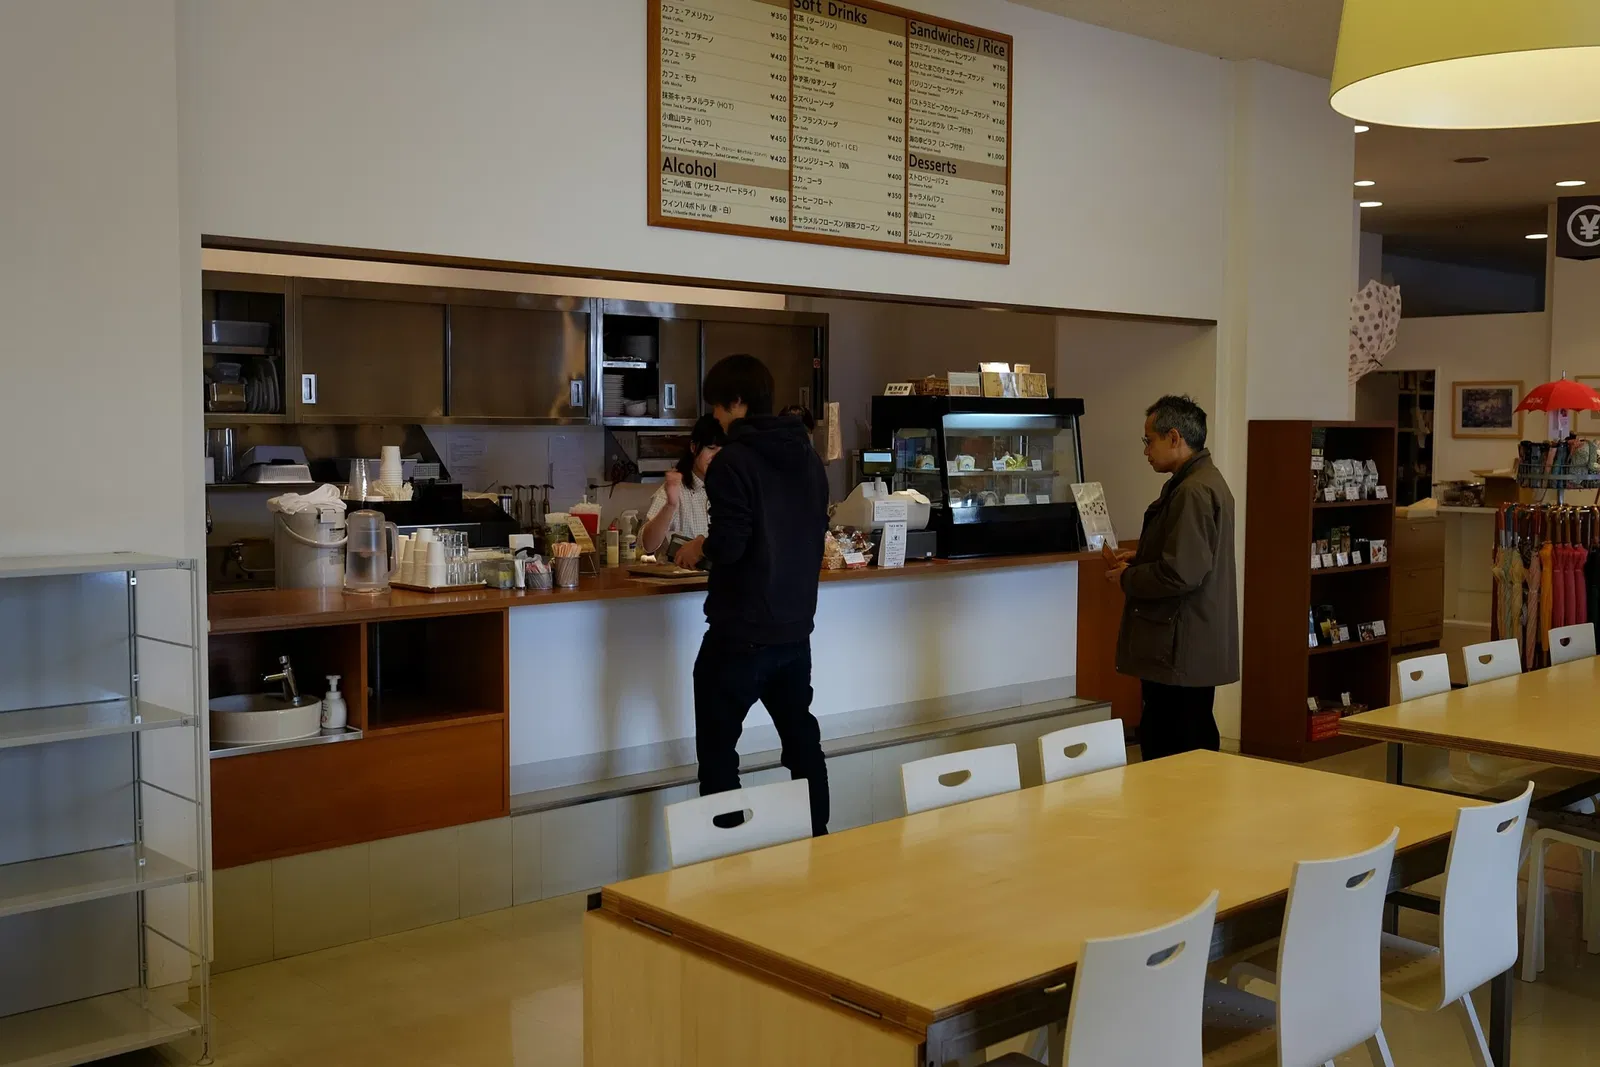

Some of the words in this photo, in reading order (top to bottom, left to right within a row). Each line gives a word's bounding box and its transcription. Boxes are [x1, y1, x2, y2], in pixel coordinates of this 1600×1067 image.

[770, 12, 788, 21] ¥350
[793, 0, 822, 14] Soft
[828, 2, 868, 24] Drinks
[662, 4, 716, 22] カフェ・アメリカン
[770, 32, 788, 42] ¥350
[662, 26, 714, 44] カフェ・カプチーノ
[770, 53, 787, 62] ¥420
[888, 39, 904, 48] ¥400
[910, 22, 975, 50] Sandwiches
[976, 38, 981, 53] /
[984, 40, 1005, 57] Rice
[662, 48, 696, 61] カフェ・ラテ
[770, 73, 787, 82] ¥420
[888, 58, 903, 68] ¥400
[662, 70, 697, 83] カフェ・モカ
[770, 94, 787, 102] ¥420
[888, 78, 903, 86] ¥420
[888, 96, 903, 106] ¥420
[794, 94, 835, 109] ラズベリーソーダ
[888, 116, 902, 124] ¥420
[770, 114, 787, 123] ¥420
[794, 114, 838, 128] ラ・フランスソーダ
[888, 134, 902, 143] ¥420
[770, 134, 787, 143] ¥450
[988, 134, 1005, 144] ¥1,000
[662, 134, 722, 150] フレーバーマキアート
[770, 155, 787, 164] ¥420
[888, 154, 902, 162] ¥420
[988, 152, 1004, 160] ¥1,000
[662, 156, 717, 178] Alcohol
[793, 156, 834, 168] オレンジジュース
[888, 173, 902, 181] ¥400
[910, 154, 957, 174] Desserts
[793, 175, 822, 185] コカ・コーラ
[888, 192, 902, 200] ¥350
[991, 189, 1004, 197] ¥700
[770, 195, 787, 204] ¥560
[793, 194, 834, 206] コーヒーフロート
[888, 210, 902, 218] ¥480
[991, 207, 1004, 215] ¥700
[770, 216, 787, 224] ¥680
[990, 224, 1004, 232] ¥700
[887, 230, 902, 238] ¥480
[990, 242, 1004, 250] ¥720
